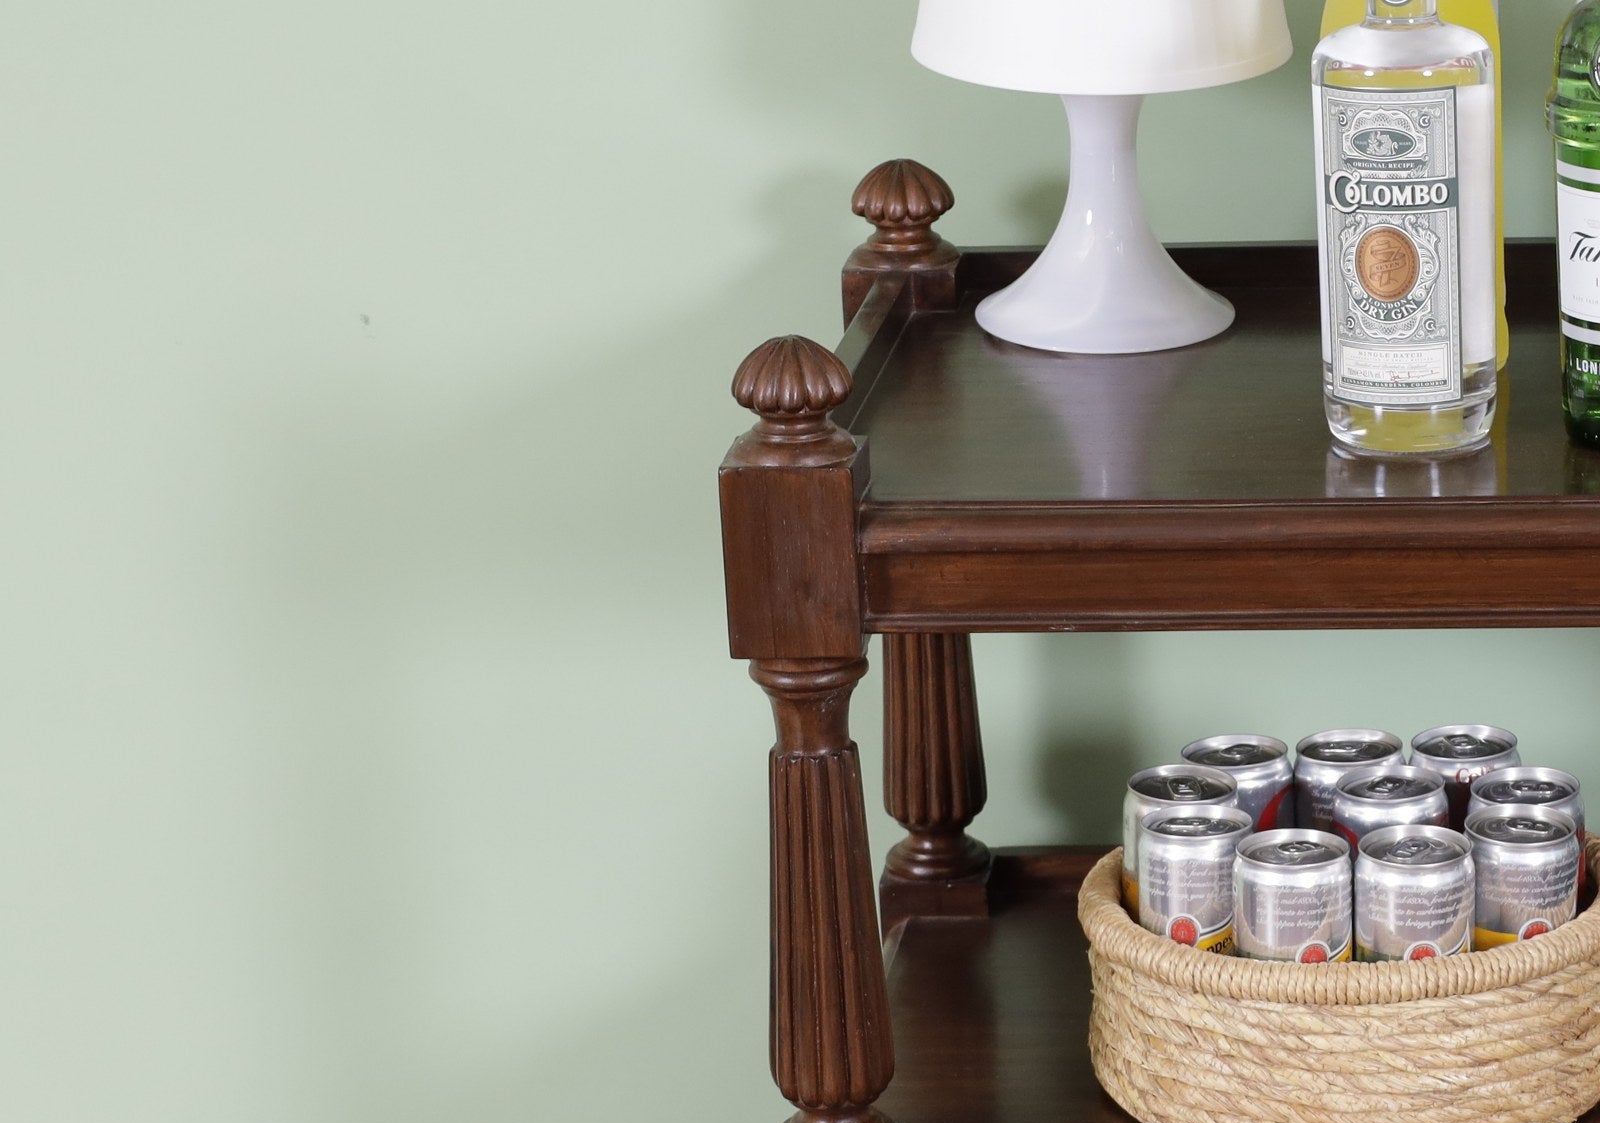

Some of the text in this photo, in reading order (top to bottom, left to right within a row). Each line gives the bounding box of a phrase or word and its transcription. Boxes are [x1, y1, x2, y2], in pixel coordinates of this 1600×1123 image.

[1329, 170, 1450, 213] COLOMBO
[1360, 299, 1418, 320] DRY GIN
[1369, 298, 1407, 308] LONDON
